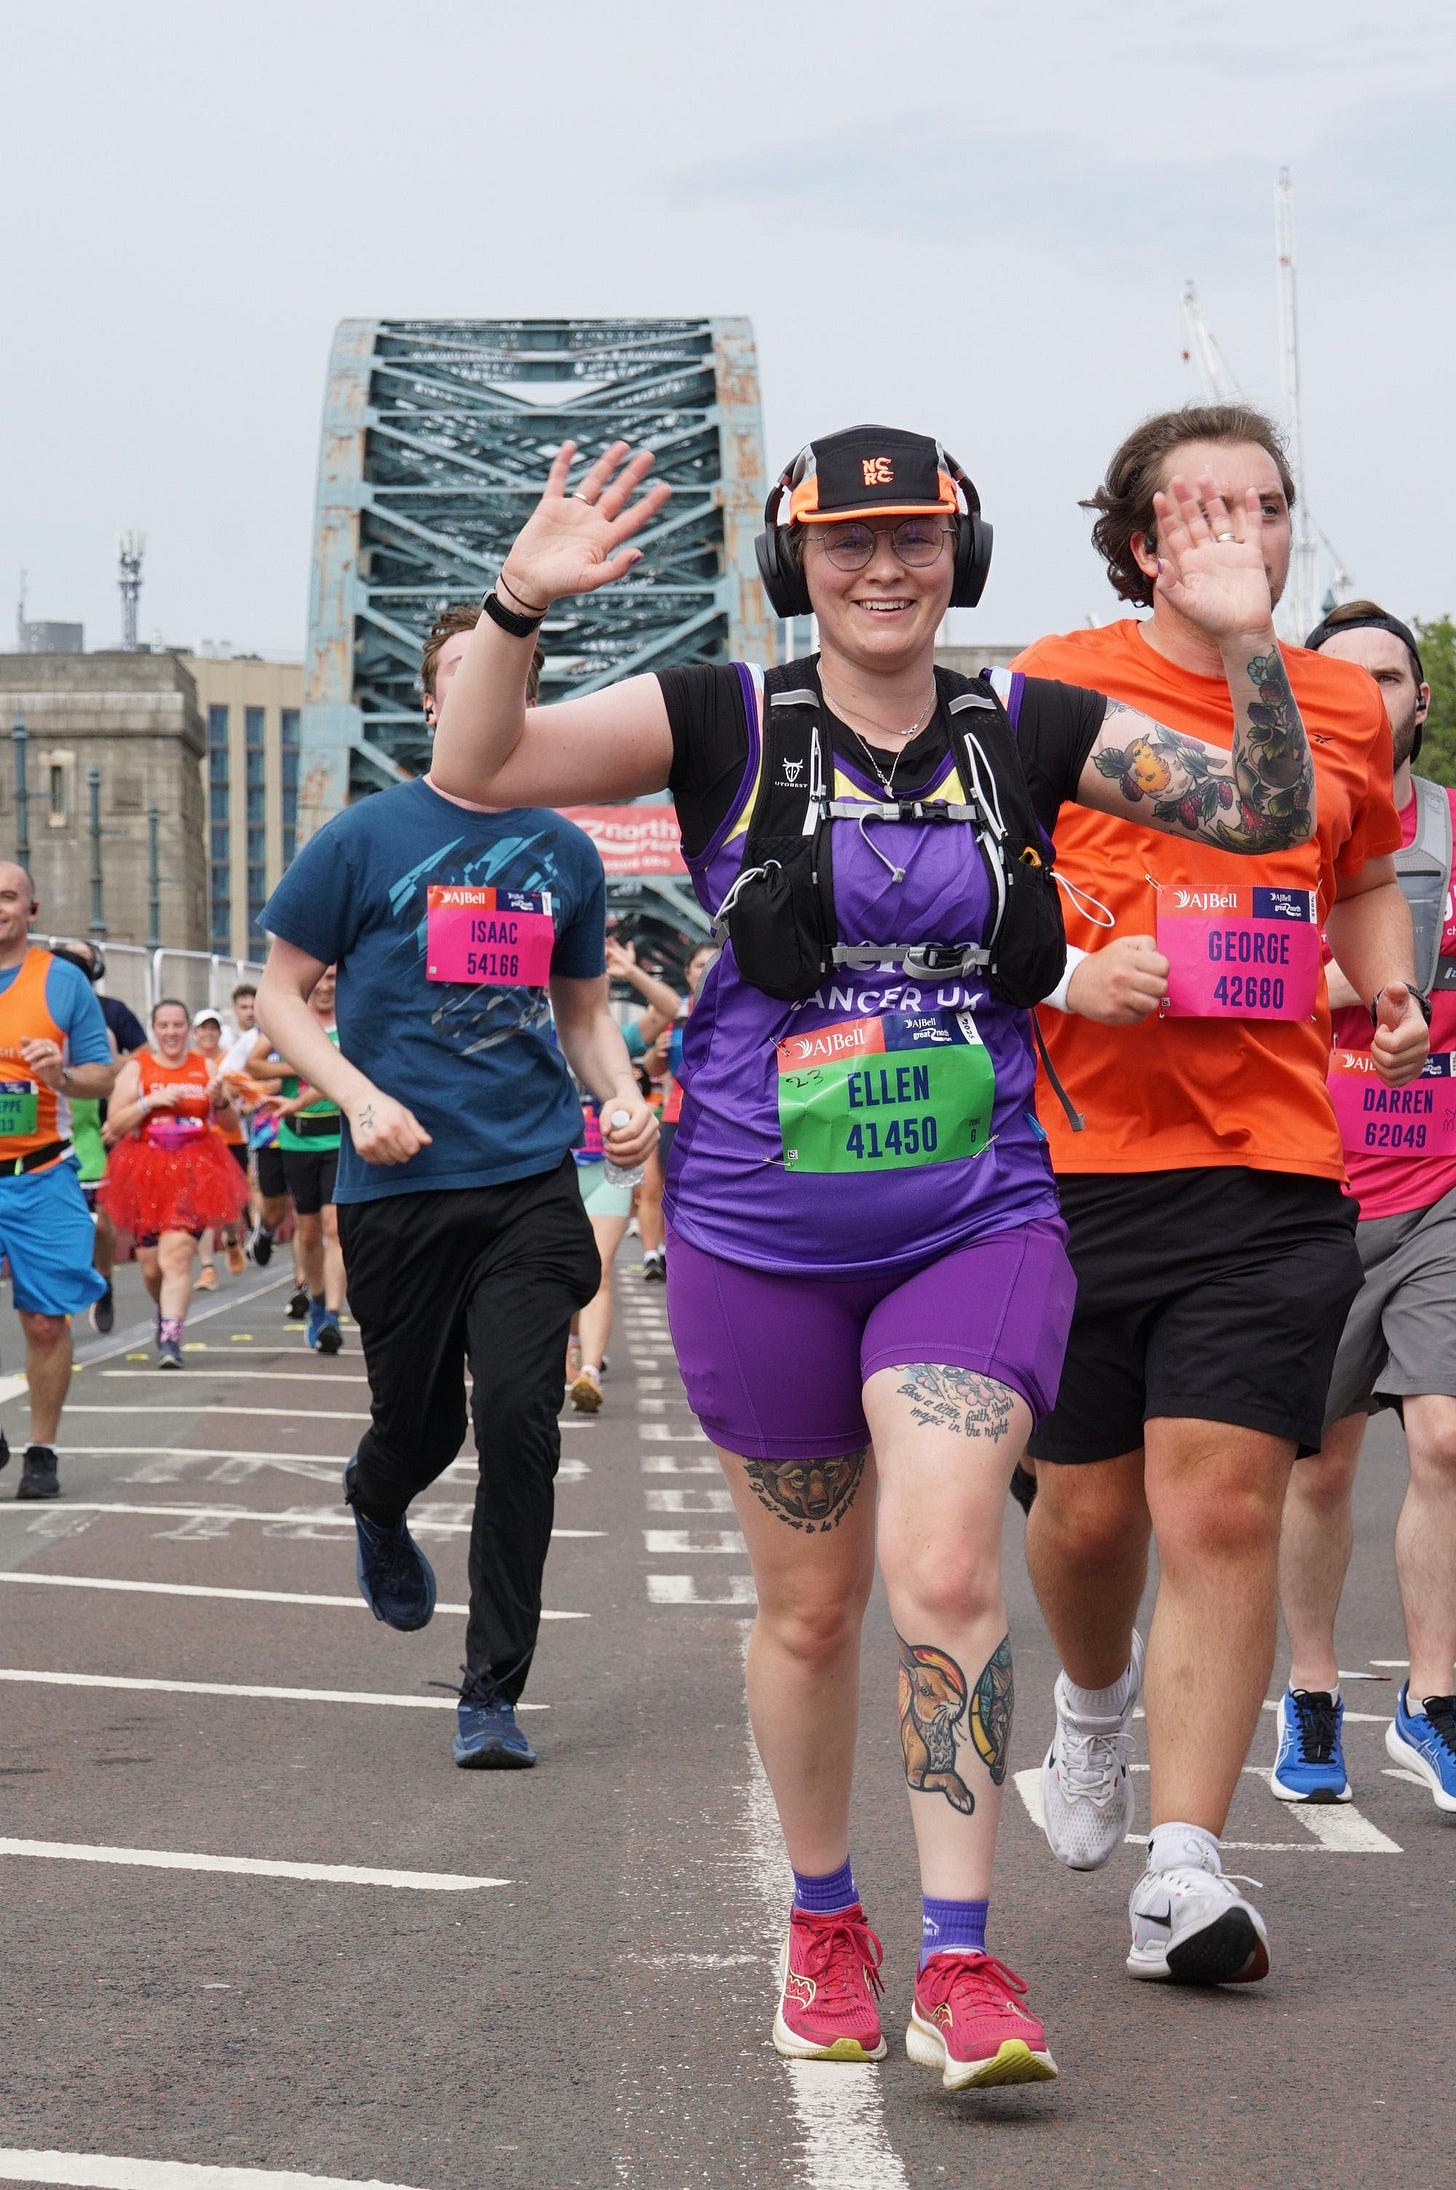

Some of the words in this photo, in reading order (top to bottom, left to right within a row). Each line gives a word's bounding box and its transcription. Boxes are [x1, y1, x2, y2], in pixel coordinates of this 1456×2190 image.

[605, 820, 679, 840] north
[1190, 892, 1237, 911] AJBell
[471, 920, 518, 944] ISAAC
[1209, 931, 1290, 964] GEORGE
[467, 952, 519, 977] 54166
[1214, 976, 1284, 1009] 42680
[913, 1031, 931, 1041] great
[961, 1018, 975, 1040] 2025
[813, 1029, 867, 1057] AJBell
[848, 1065, 930, 1108] ELLEN
[1363, 1087, 1434, 1114] DARREN
[846, 1116, 938, 1160] 41450
[1364, 1122, 1427, 1148] 62049
[909, 1407, 945, 1426] magic
[947, 1419, 961, 1433] in
[965, 1421, 981, 1437] the
